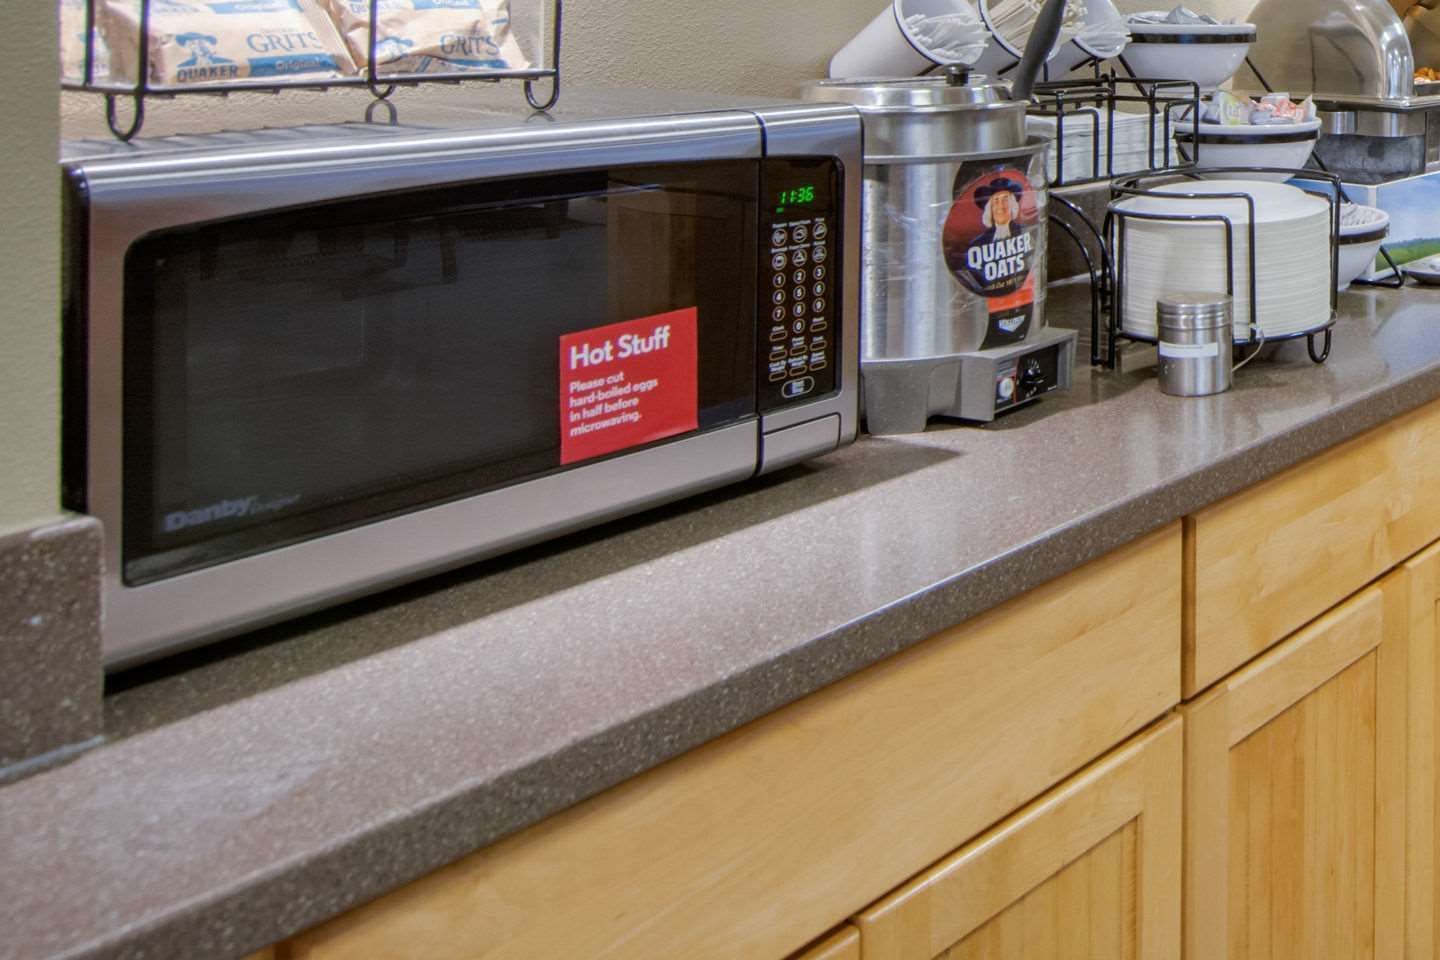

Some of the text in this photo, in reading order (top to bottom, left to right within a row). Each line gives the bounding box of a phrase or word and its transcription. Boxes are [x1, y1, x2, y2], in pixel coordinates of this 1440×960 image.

[246, 31, 322, 52] GRITS
[440, 32, 501, 57] GRITS
[176, 64, 240, 83] QUAKER
[781, 186, 814, 204] 11:36
[967, 231, 1032, 271] QUAKER
[984, 253, 1025, 282] OATS
[569, 325, 671, 370] Hot Stuff
[569, 371, 625, 394] Please cut
[569, 378, 658, 408] hard-boiled eggs
[569, 397, 640, 422] in half before
[569, 410, 642, 437] microwaving.
[163, 497, 256, 531] Danby
